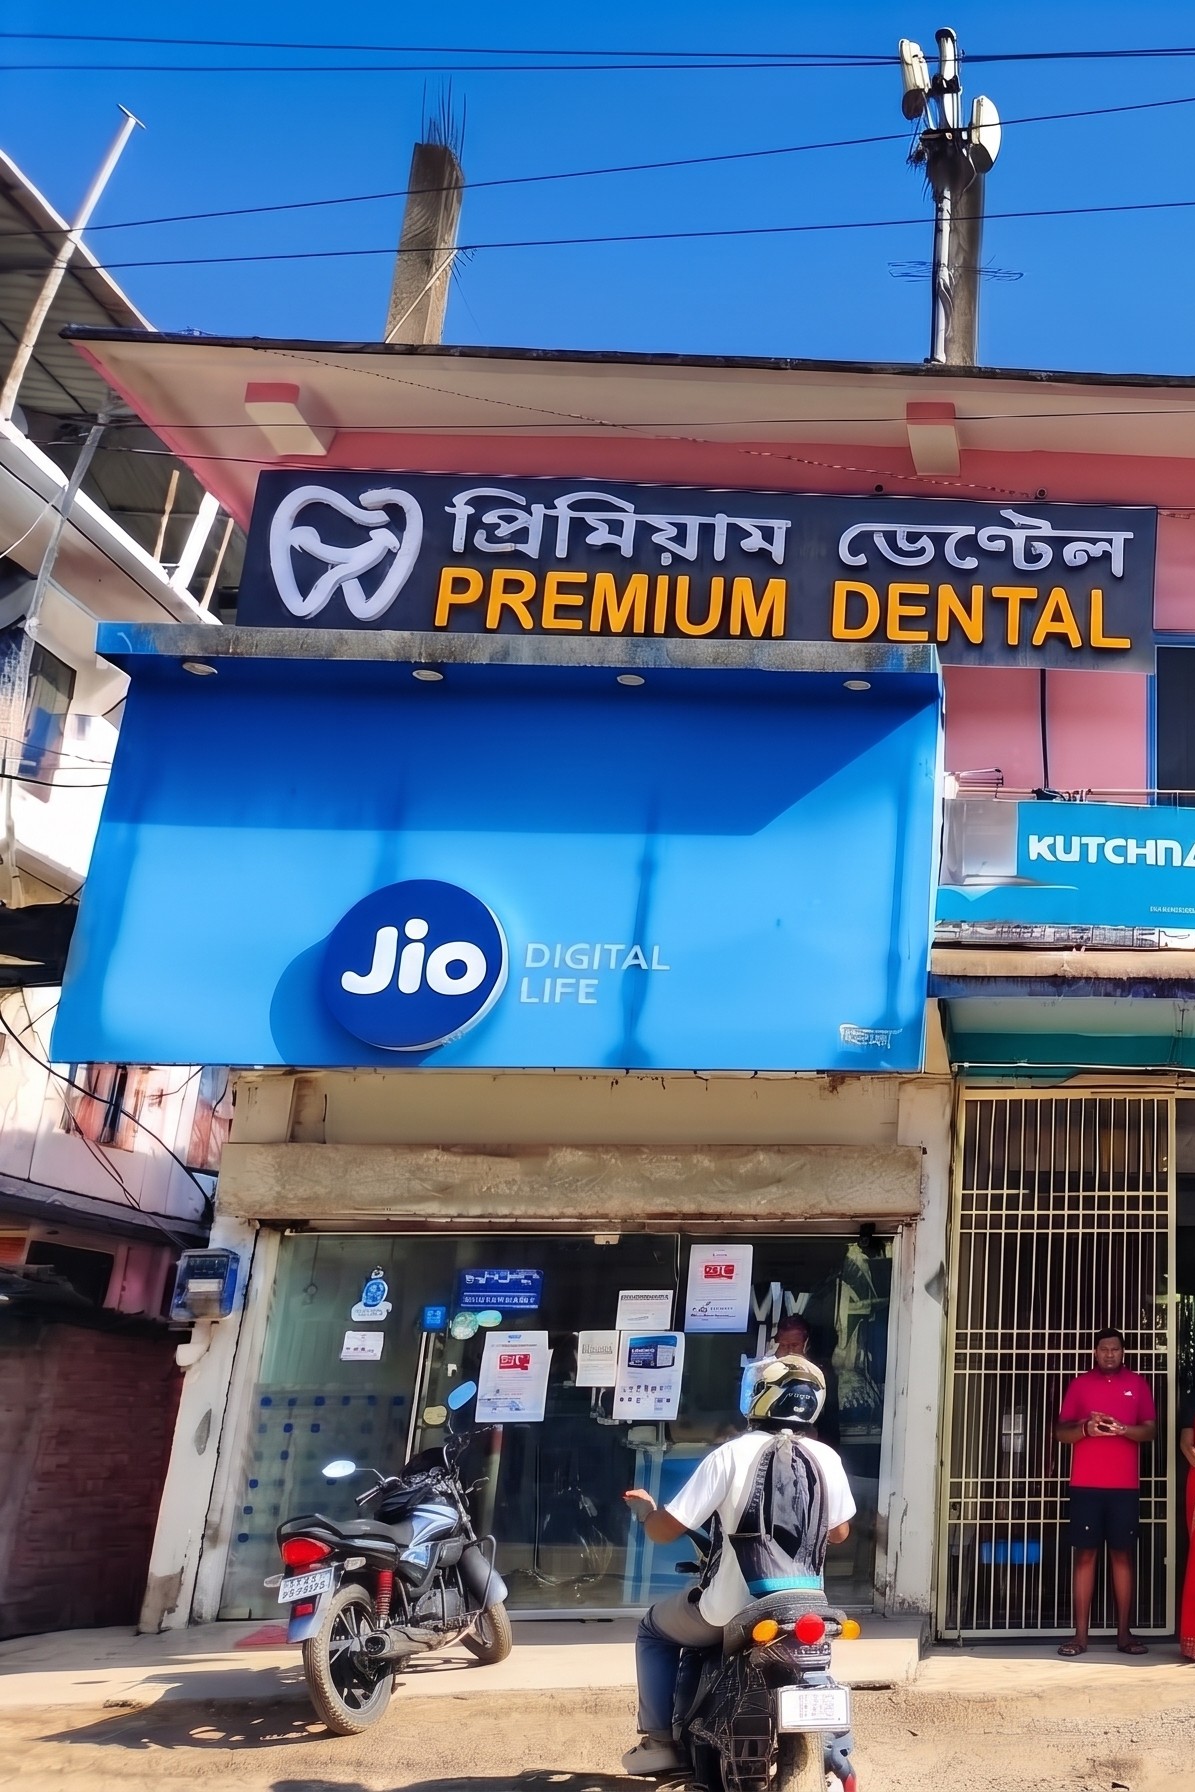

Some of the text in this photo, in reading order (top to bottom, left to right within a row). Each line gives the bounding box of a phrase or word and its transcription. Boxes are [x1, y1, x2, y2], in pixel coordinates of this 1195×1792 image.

[434, 567, 1132, 649] PREMIUM DENTAL
[341, 918, 487, 995] Jio
[525, 943, 671, 971] DIGITAL
[519, 977, 599, 1004] LIFE
